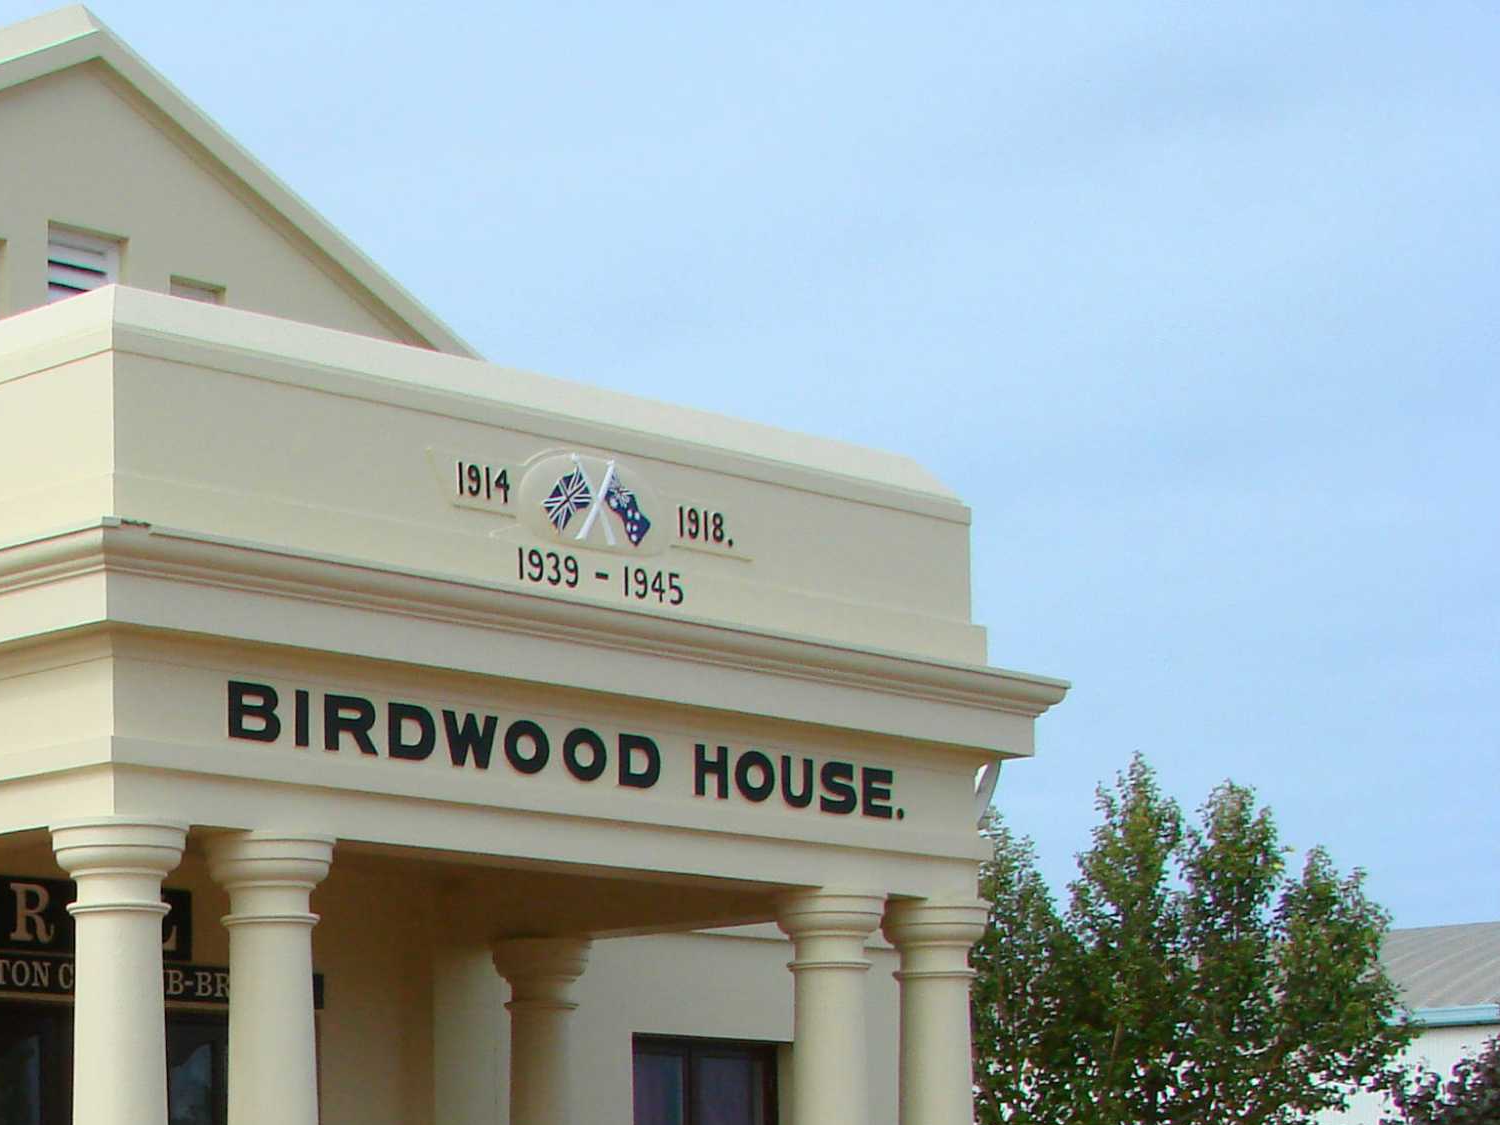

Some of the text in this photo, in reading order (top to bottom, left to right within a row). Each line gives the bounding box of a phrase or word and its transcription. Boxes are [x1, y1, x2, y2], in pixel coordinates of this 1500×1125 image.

[456, 461, 734, 547] 1914 1918.
[518, 547, 579, 587] 1939
[624, 566, 684, 605] 1945
[227, 680, 905, 820] BIRDWOOD HOUSE.
